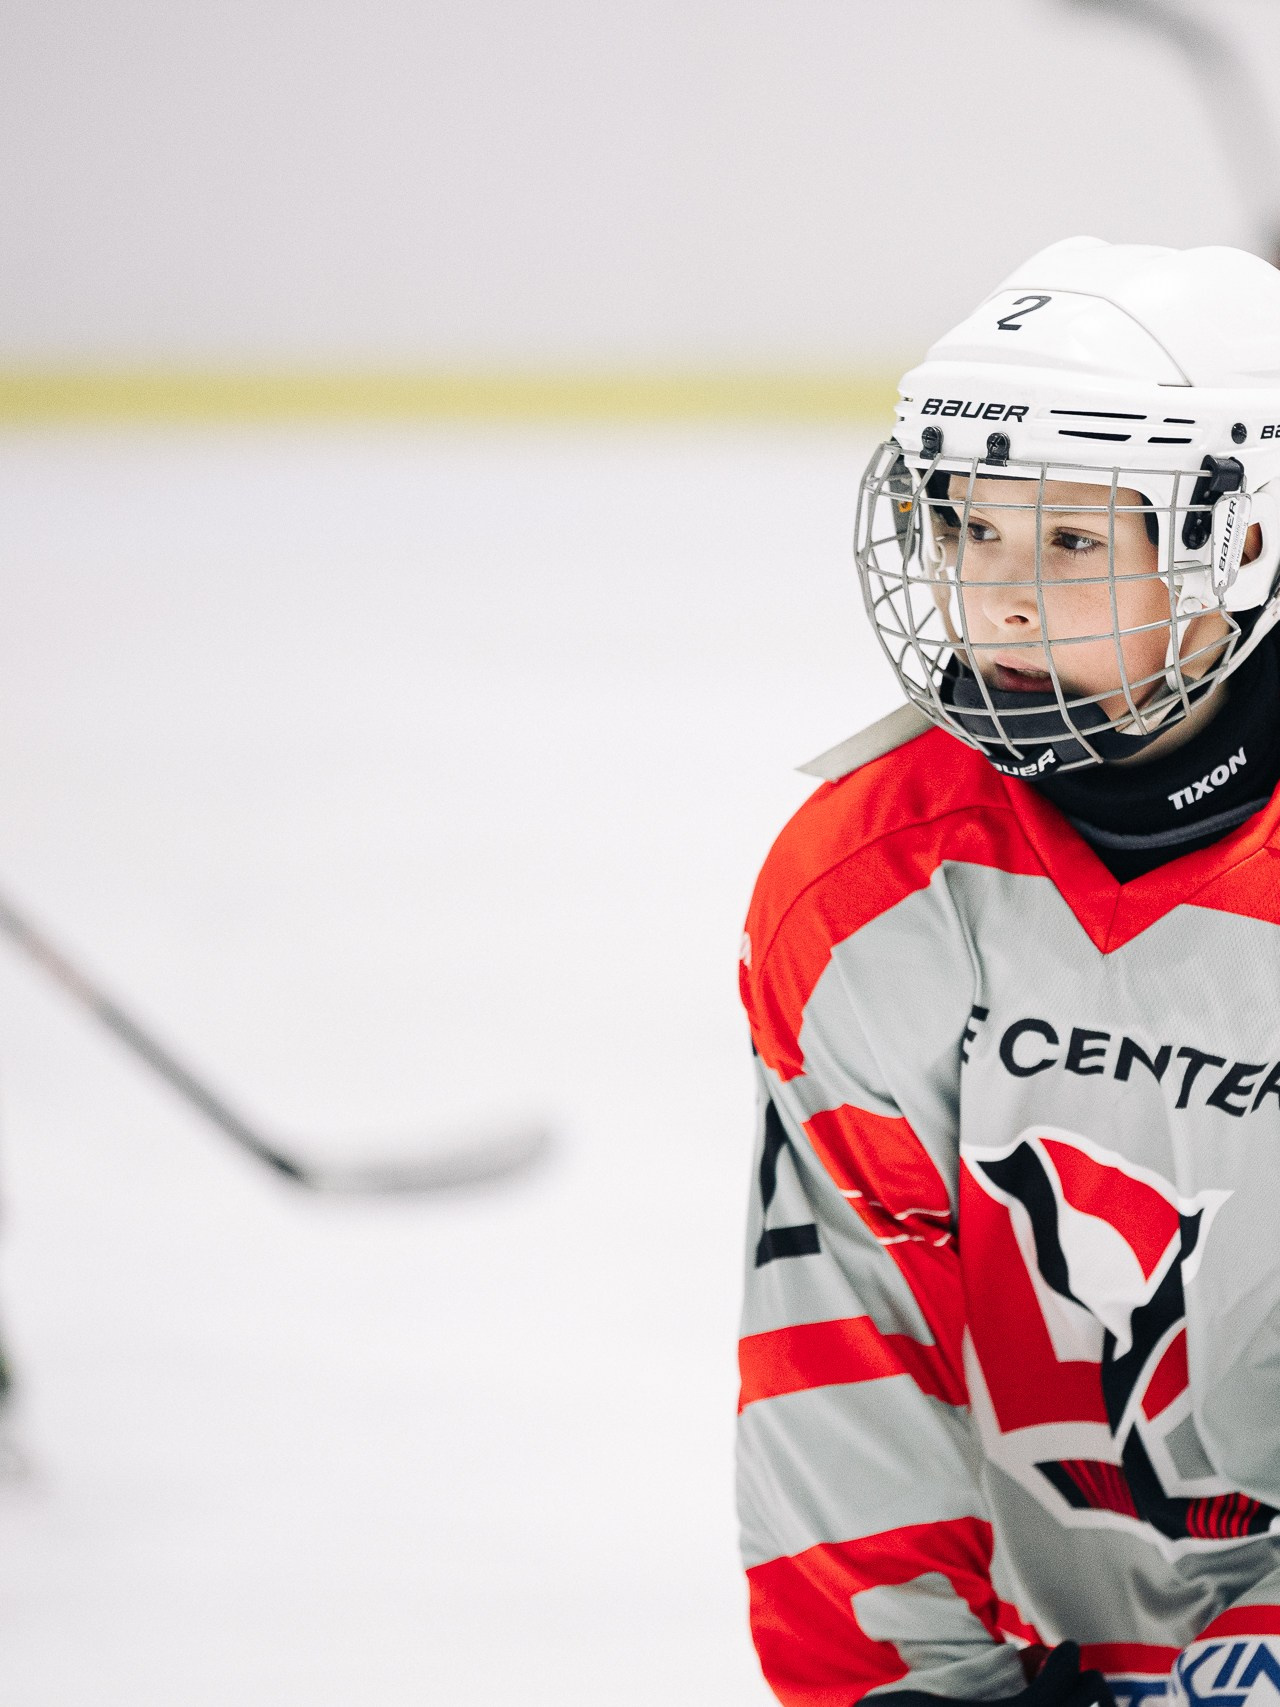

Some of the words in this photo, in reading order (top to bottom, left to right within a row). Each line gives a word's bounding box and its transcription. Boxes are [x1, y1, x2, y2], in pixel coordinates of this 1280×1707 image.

[997, 295, 1052, 331] 2
[920, 398, 1029, 423] BAUER
[1218, 499, 1237, 572] BAUER
[1167, 746, 1247, 810] TIXON
